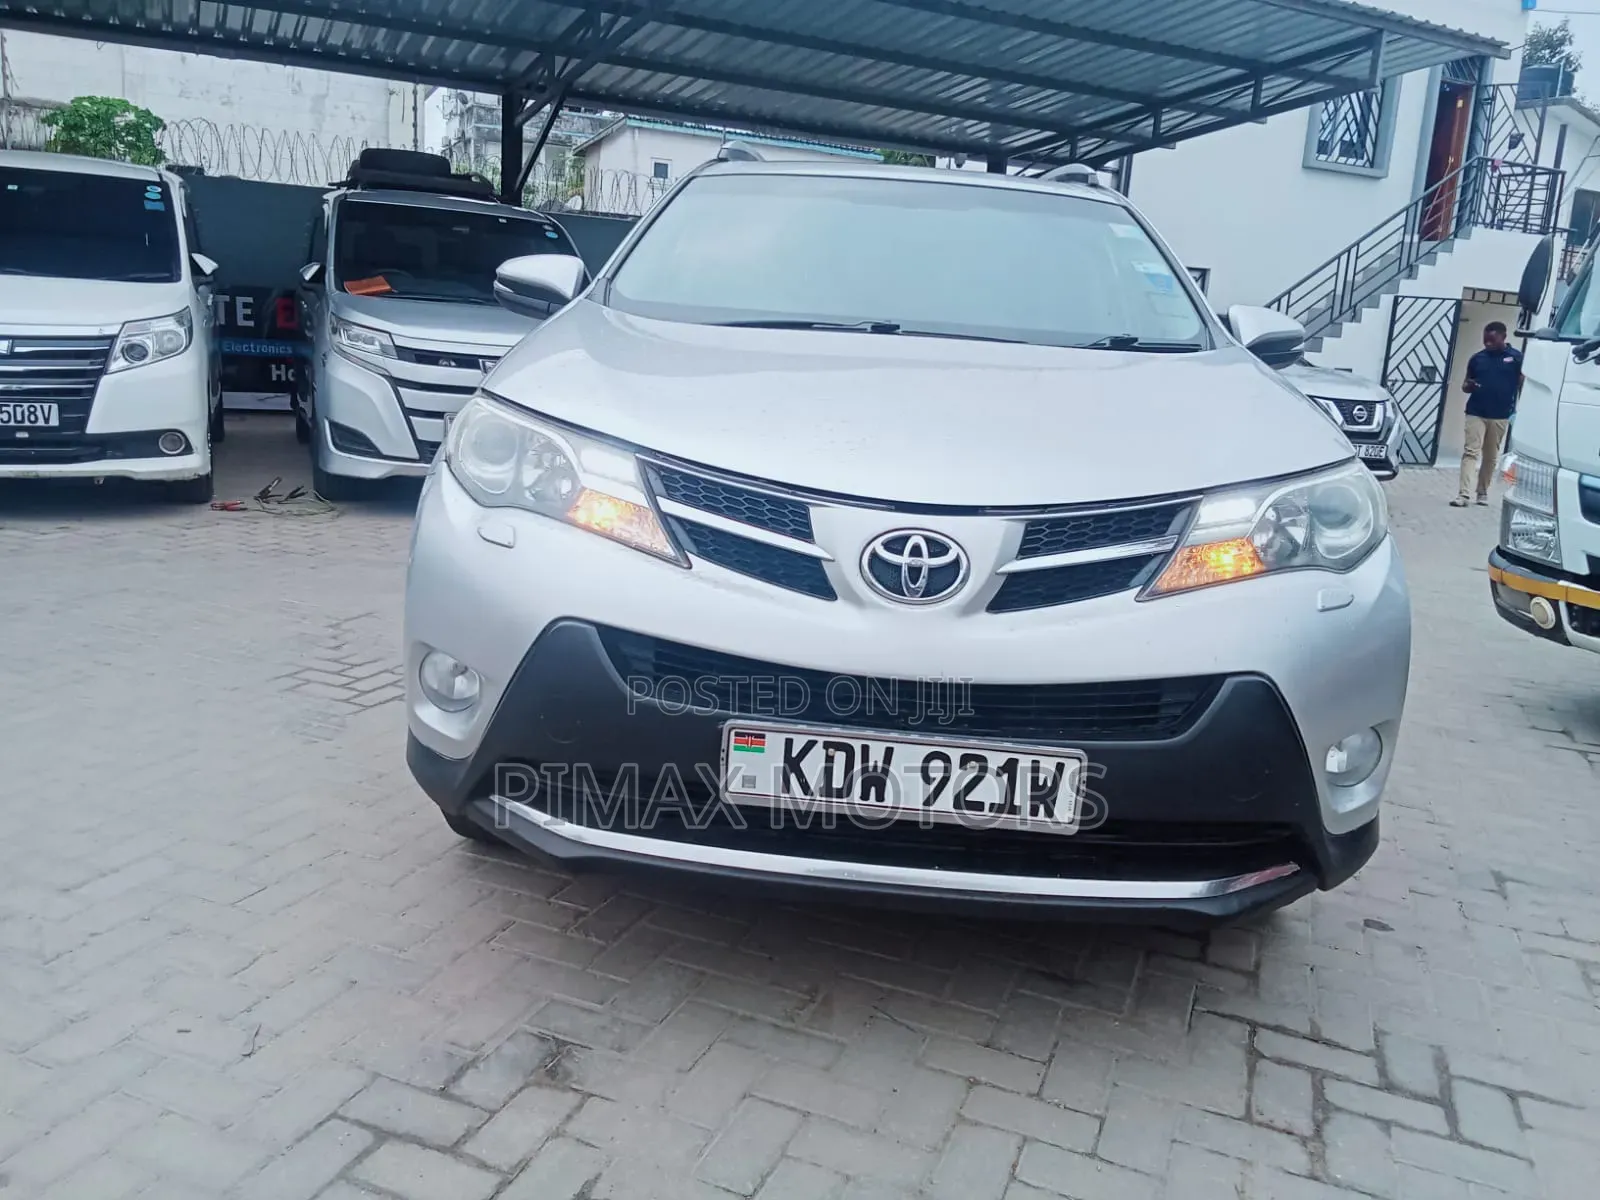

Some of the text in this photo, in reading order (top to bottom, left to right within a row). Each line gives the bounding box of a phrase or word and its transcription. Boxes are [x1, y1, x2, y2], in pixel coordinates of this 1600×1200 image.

[223, 341, 293, 354] Electronics
[0, 403, 52, 425] 508V
[782, 737, 1066, 819] KDW 921W
